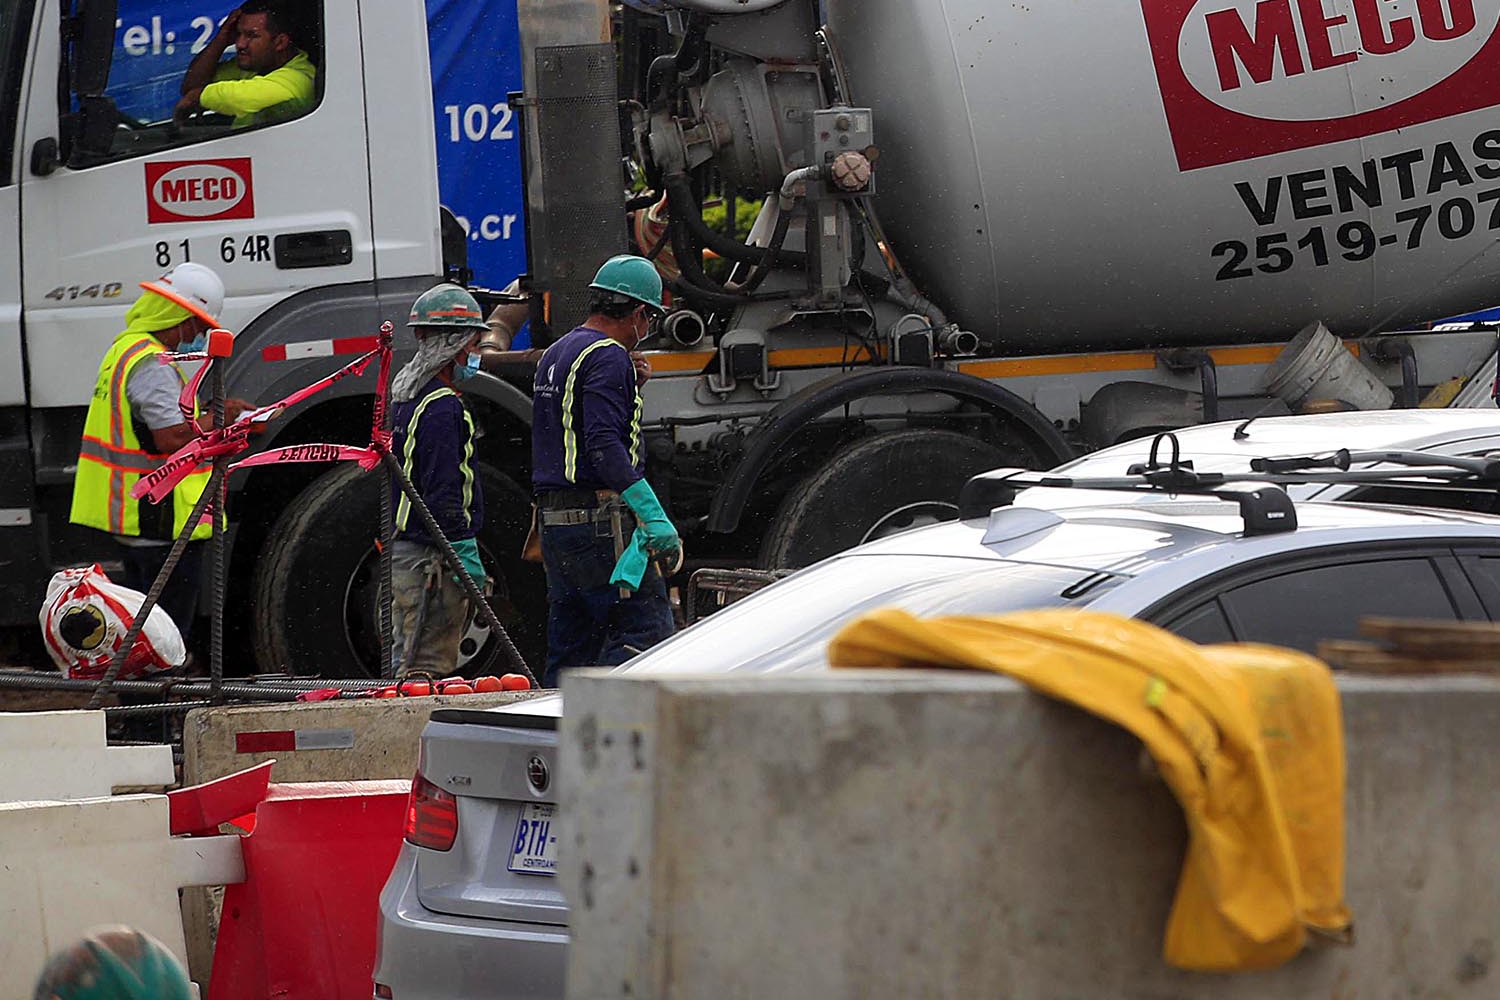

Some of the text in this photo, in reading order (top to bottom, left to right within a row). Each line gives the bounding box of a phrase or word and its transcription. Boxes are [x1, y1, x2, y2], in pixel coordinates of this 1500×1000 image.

[444, 102, 514, 142] 102
[161, 176, 237, 203] MECO
[45, 282, 123, 301] 4140
